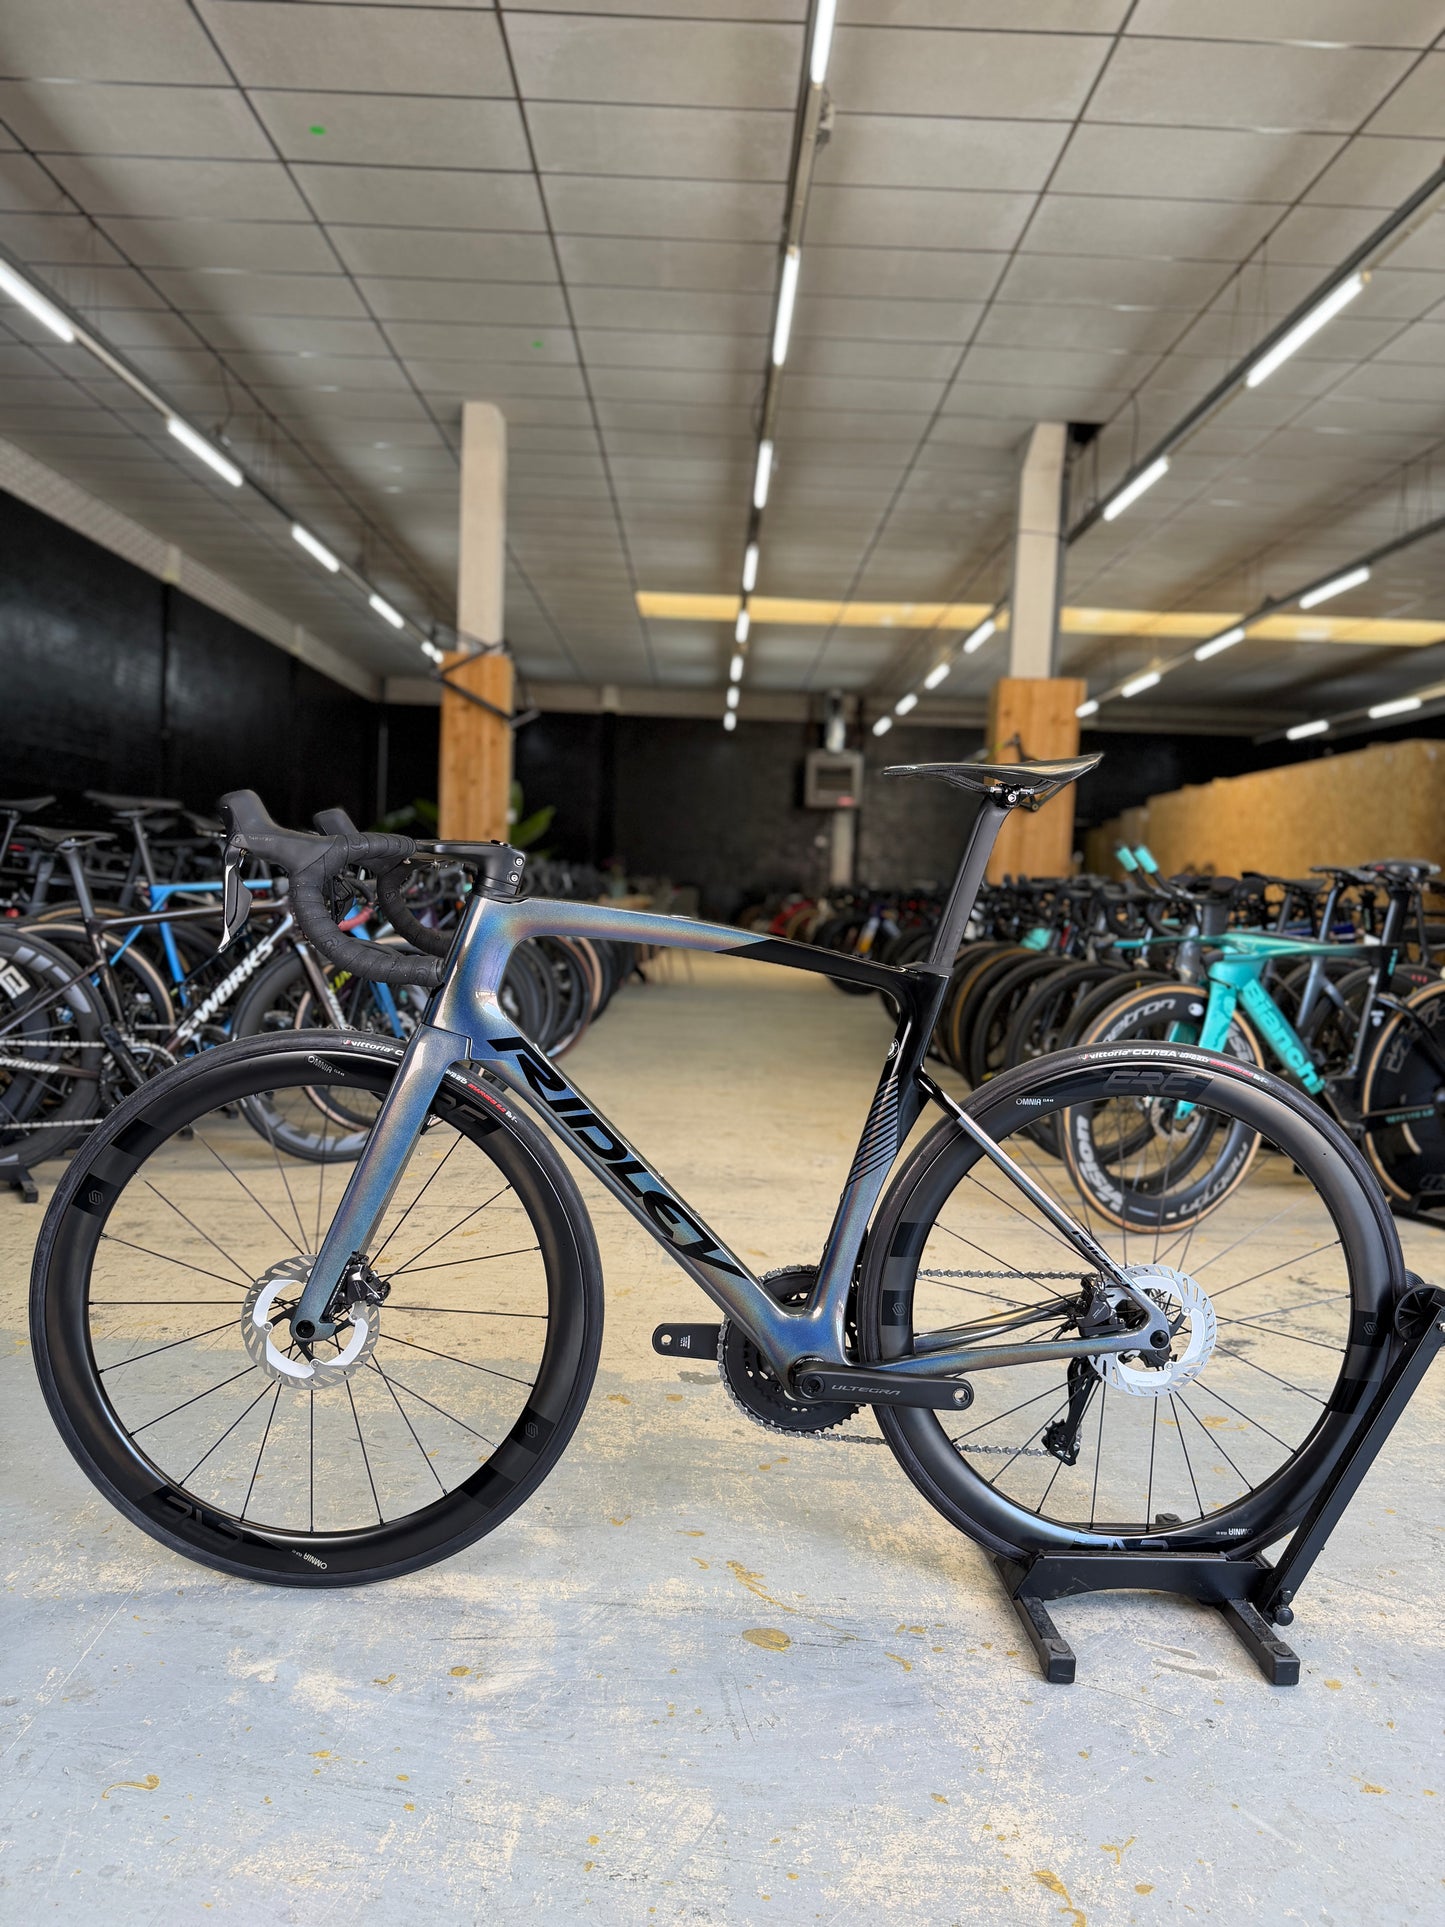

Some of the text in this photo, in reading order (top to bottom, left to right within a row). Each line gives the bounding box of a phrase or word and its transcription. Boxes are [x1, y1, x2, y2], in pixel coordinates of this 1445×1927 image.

[176, 936, 274, 1046] S-WORKS
[351, 1039, 393, 1052] vittoria
[1242, 979, 1326, 1095] Bianchi
[1089, 1049, 1130, 1060] vittoria
[1132, 1048, 1178, 1058] CORSA
[1103, 1070, 1197, 1095] ERE
[1015, 1097, 1042, 1106] OMNIA
[487, 1036, 752, 1281] RIDLEY
[831, 1384, 901, 1397] ULTEGRA
